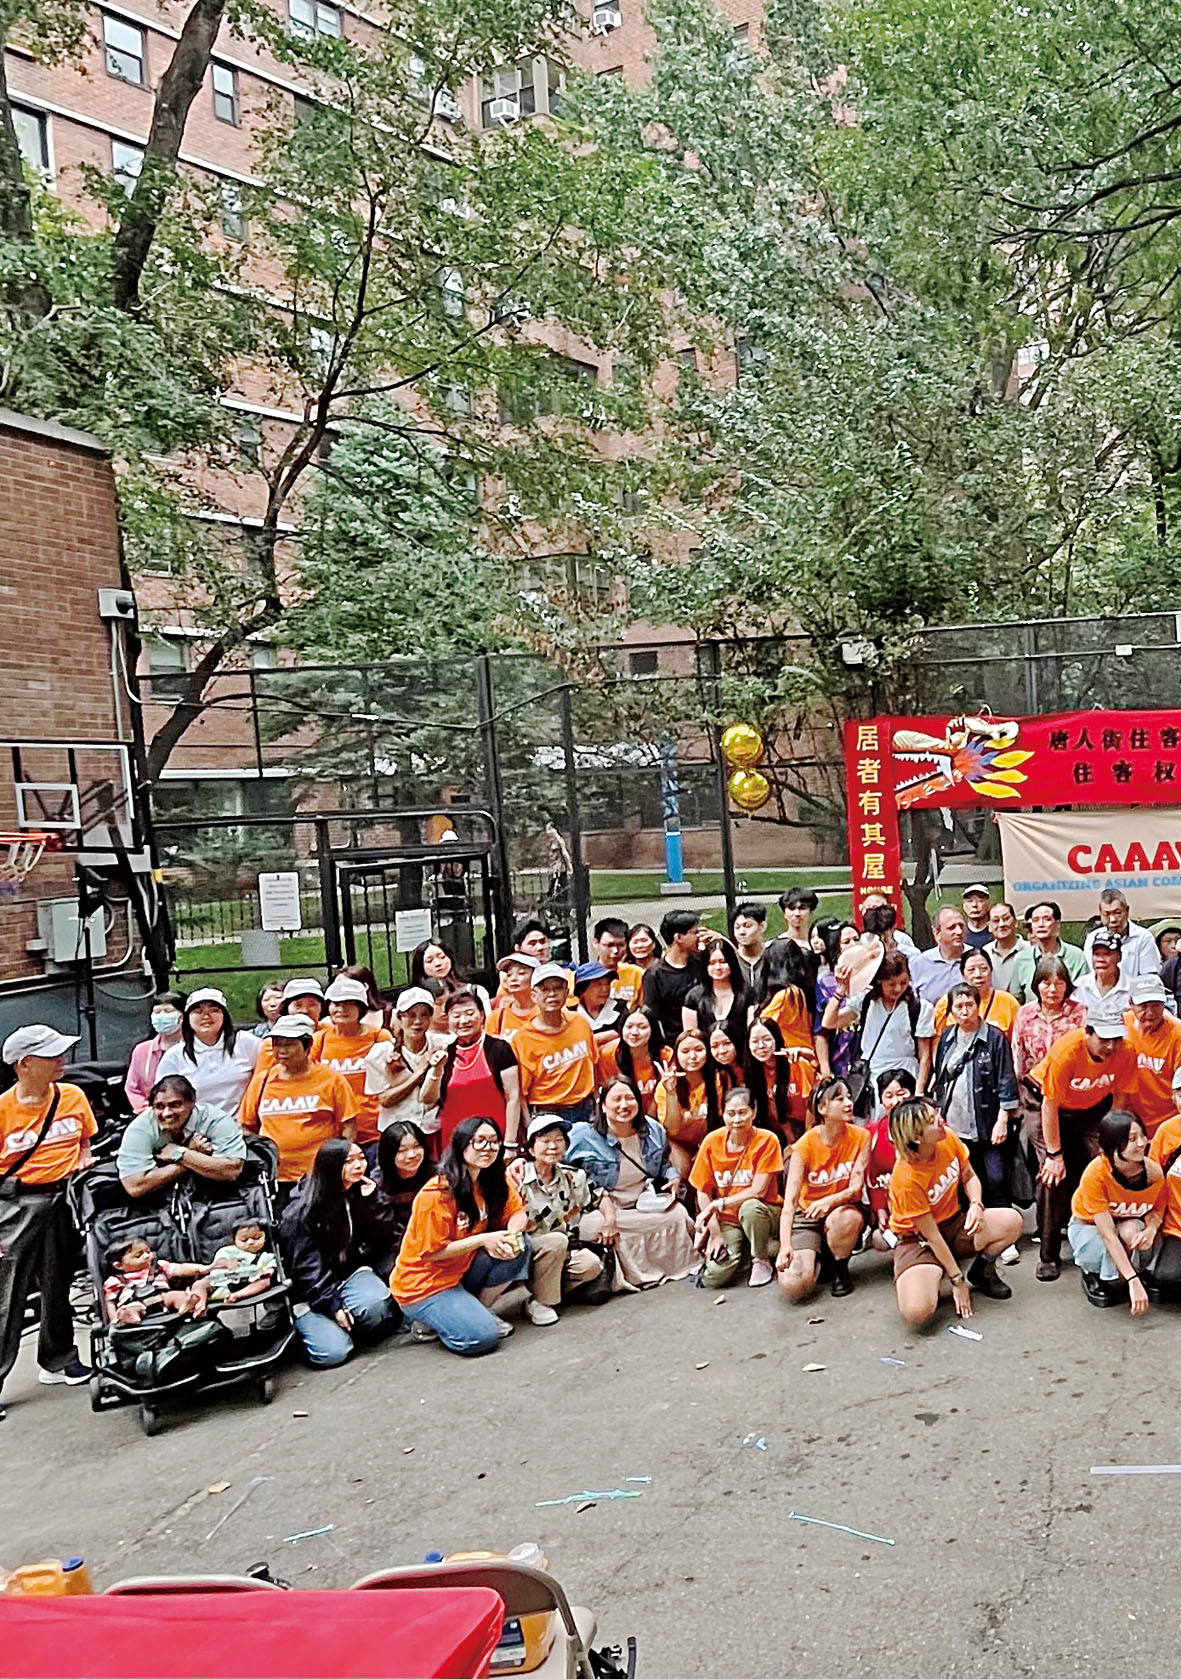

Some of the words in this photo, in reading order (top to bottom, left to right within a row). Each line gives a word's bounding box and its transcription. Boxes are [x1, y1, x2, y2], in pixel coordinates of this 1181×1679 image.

[856, 725, 887, 880] 居者有其屋
[1012, 880, 1101, 892] ORGANIZING
[1105, 877, 1148, 889] ASIAN
[543, 1040, 588, 1070] CAAAV
[259, 1095, 320, 1113] CAAAV
